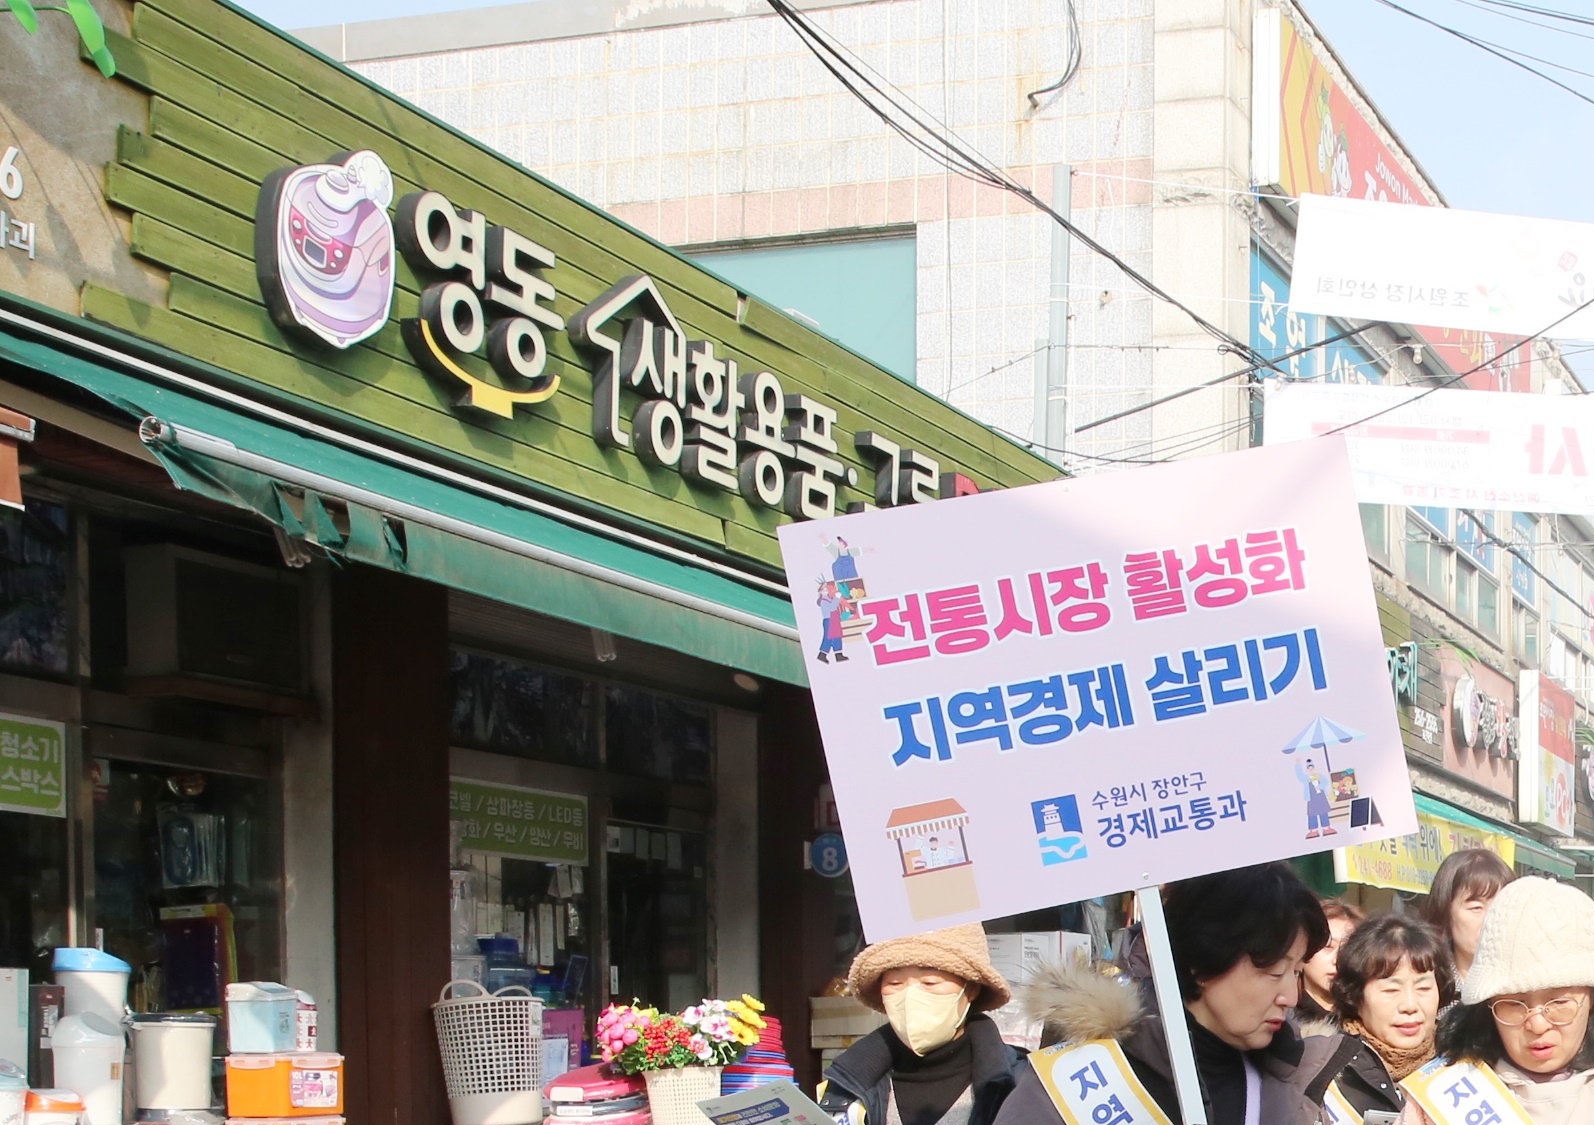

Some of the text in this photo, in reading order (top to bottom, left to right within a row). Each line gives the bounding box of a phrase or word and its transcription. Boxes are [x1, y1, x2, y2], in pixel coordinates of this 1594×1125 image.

[1374, 153, 1403, 190] Jowon
[412, 190, 837, 519] 영동 생활용품
[861, 528, 1306, 665] 전통시장 활성화
[884, 664, 1133, 766] 지역경제
[1146, 628, 1327, 722] 살리기
[0, 731, 59, 764] 청소기
[1091, 772, 1207, 809] 수원시 장안구
[487, 795, 535, 820] 삼파장등
[550, 804, 583, 827] LED등
[1098, 790, 1247, 847] 경제교통과
[494, 823, 518, 844] 우산
[530, 826, 551, 848] 양산
[563, 831, 584, 850] 우비
[822, 847, 838, 871] 8
